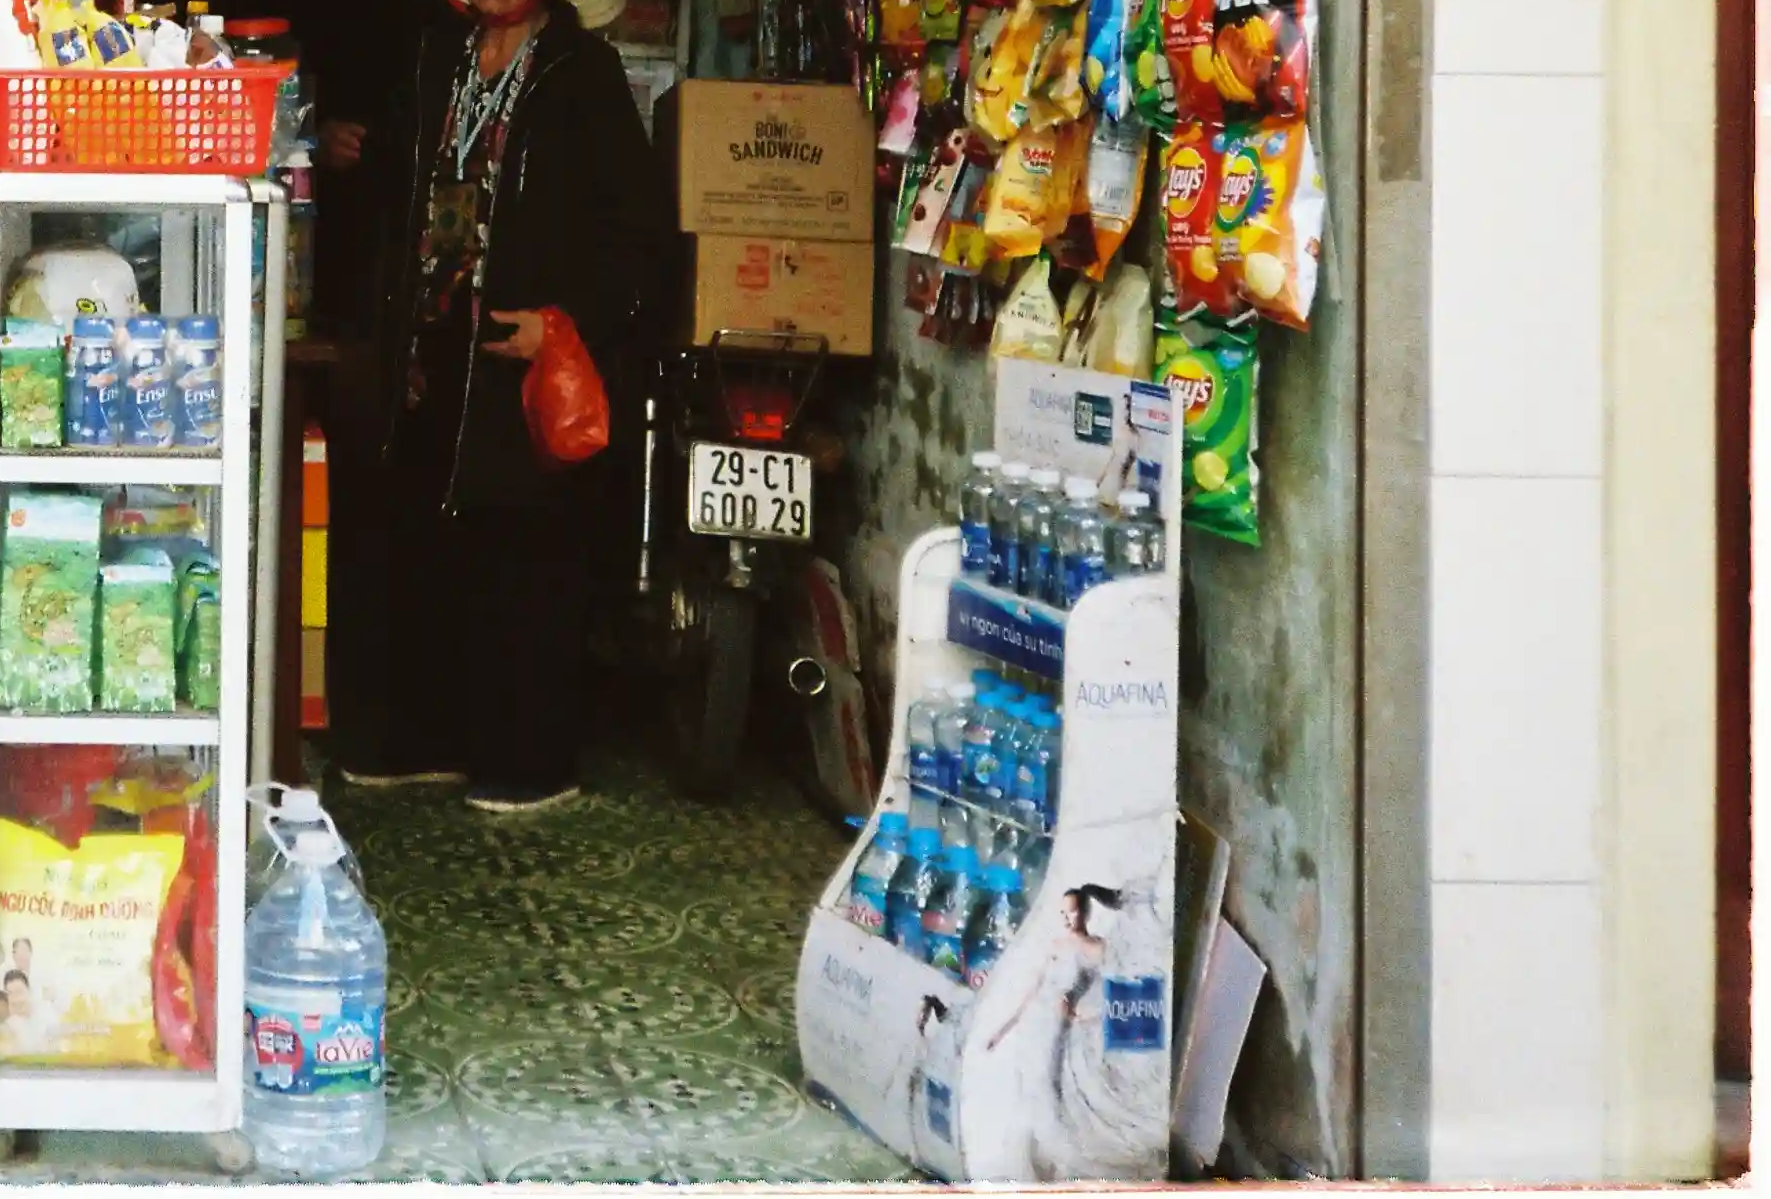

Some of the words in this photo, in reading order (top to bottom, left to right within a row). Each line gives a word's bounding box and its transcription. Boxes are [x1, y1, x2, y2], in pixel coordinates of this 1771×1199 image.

[729, 140, 824, 166] SANDWICH
[711, 449, 795, 494] 29-C1
[972, 616, 1000, 639] ngon
[1077, 681, 1167, 710] AQUAFINA
